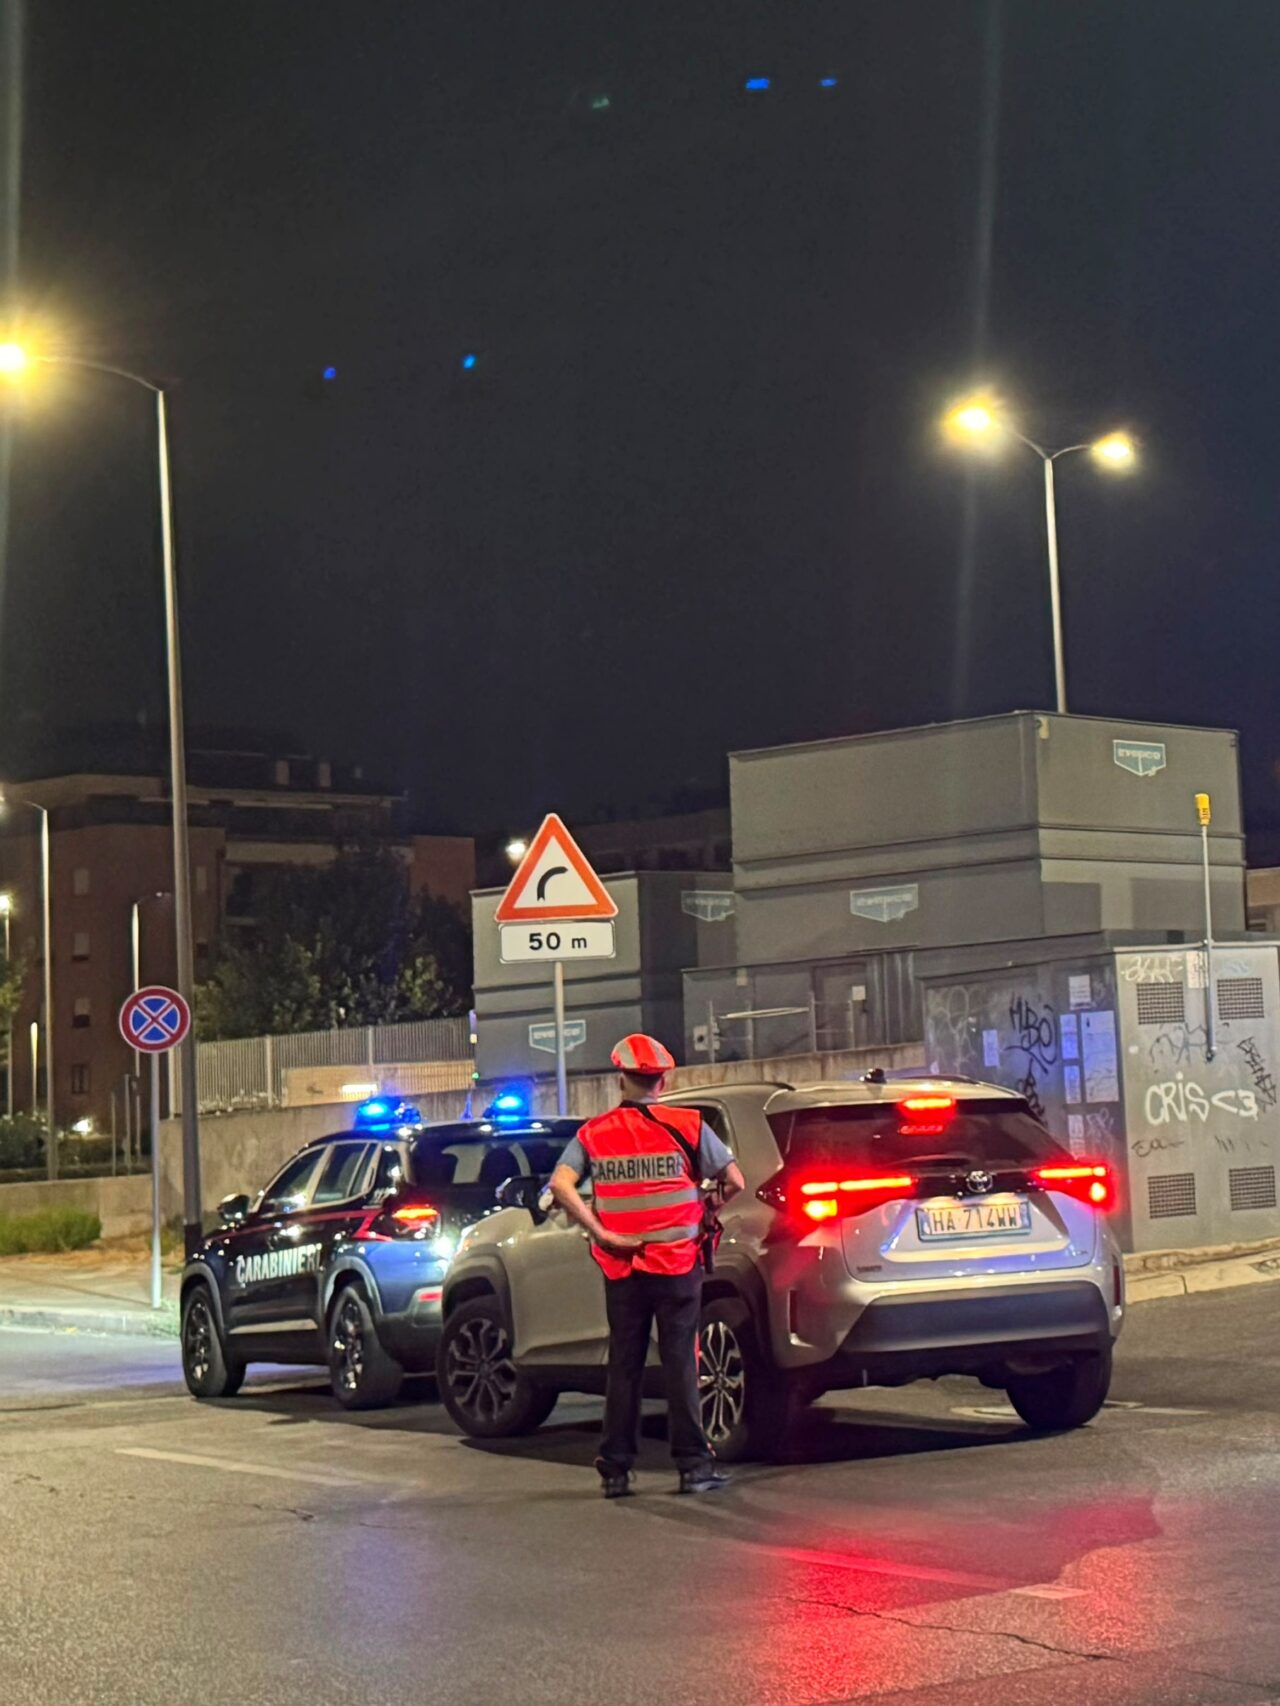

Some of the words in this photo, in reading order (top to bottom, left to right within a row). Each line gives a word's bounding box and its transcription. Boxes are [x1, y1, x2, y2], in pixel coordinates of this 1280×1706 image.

[529, 931, 562, 951] 50
[571, 937, 588, 949] m
[236, 1242, 323, 1283] CARABINIERI
